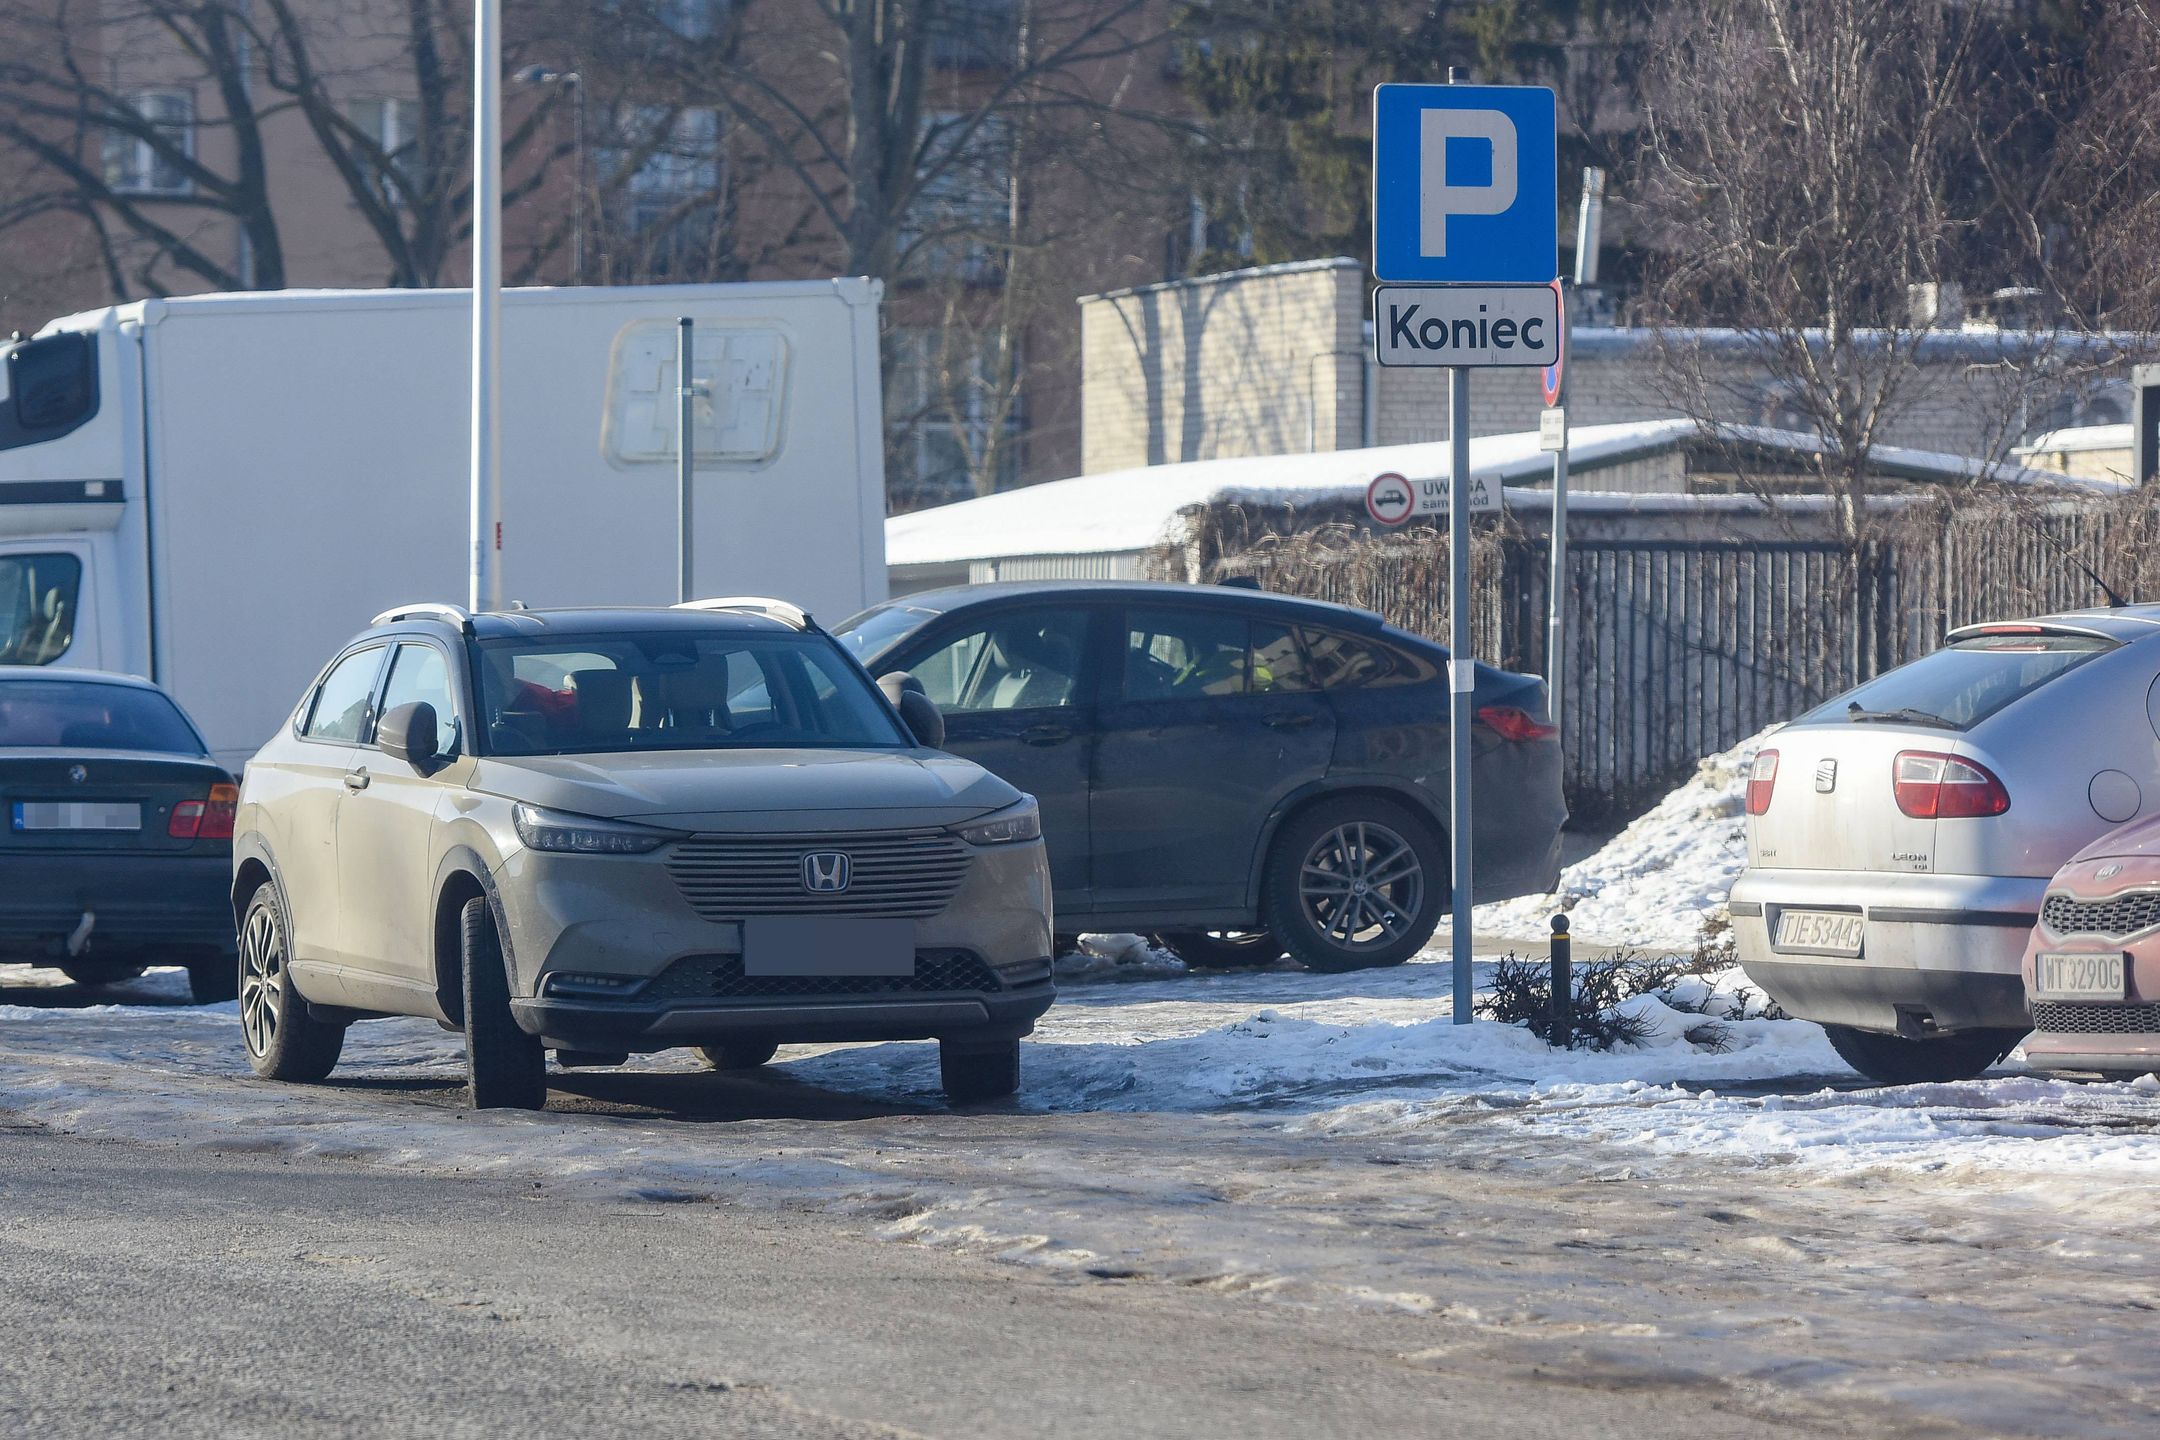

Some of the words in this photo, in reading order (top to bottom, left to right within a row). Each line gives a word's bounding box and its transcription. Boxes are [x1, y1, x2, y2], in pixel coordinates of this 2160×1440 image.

[1420, 108, 1518, 257] P
[1389, 304, 1545, 350] Koniec
[1422, 495, 1489, 509] samód
[1891, 851, 1927, 862] LEON
[1783, 915, 1812, 944] TJE
[1811, 916, 1863, 947] 53443
[2046, 957, 2064, 990] WT
[2069, 958, 2121, 990] 3290G
